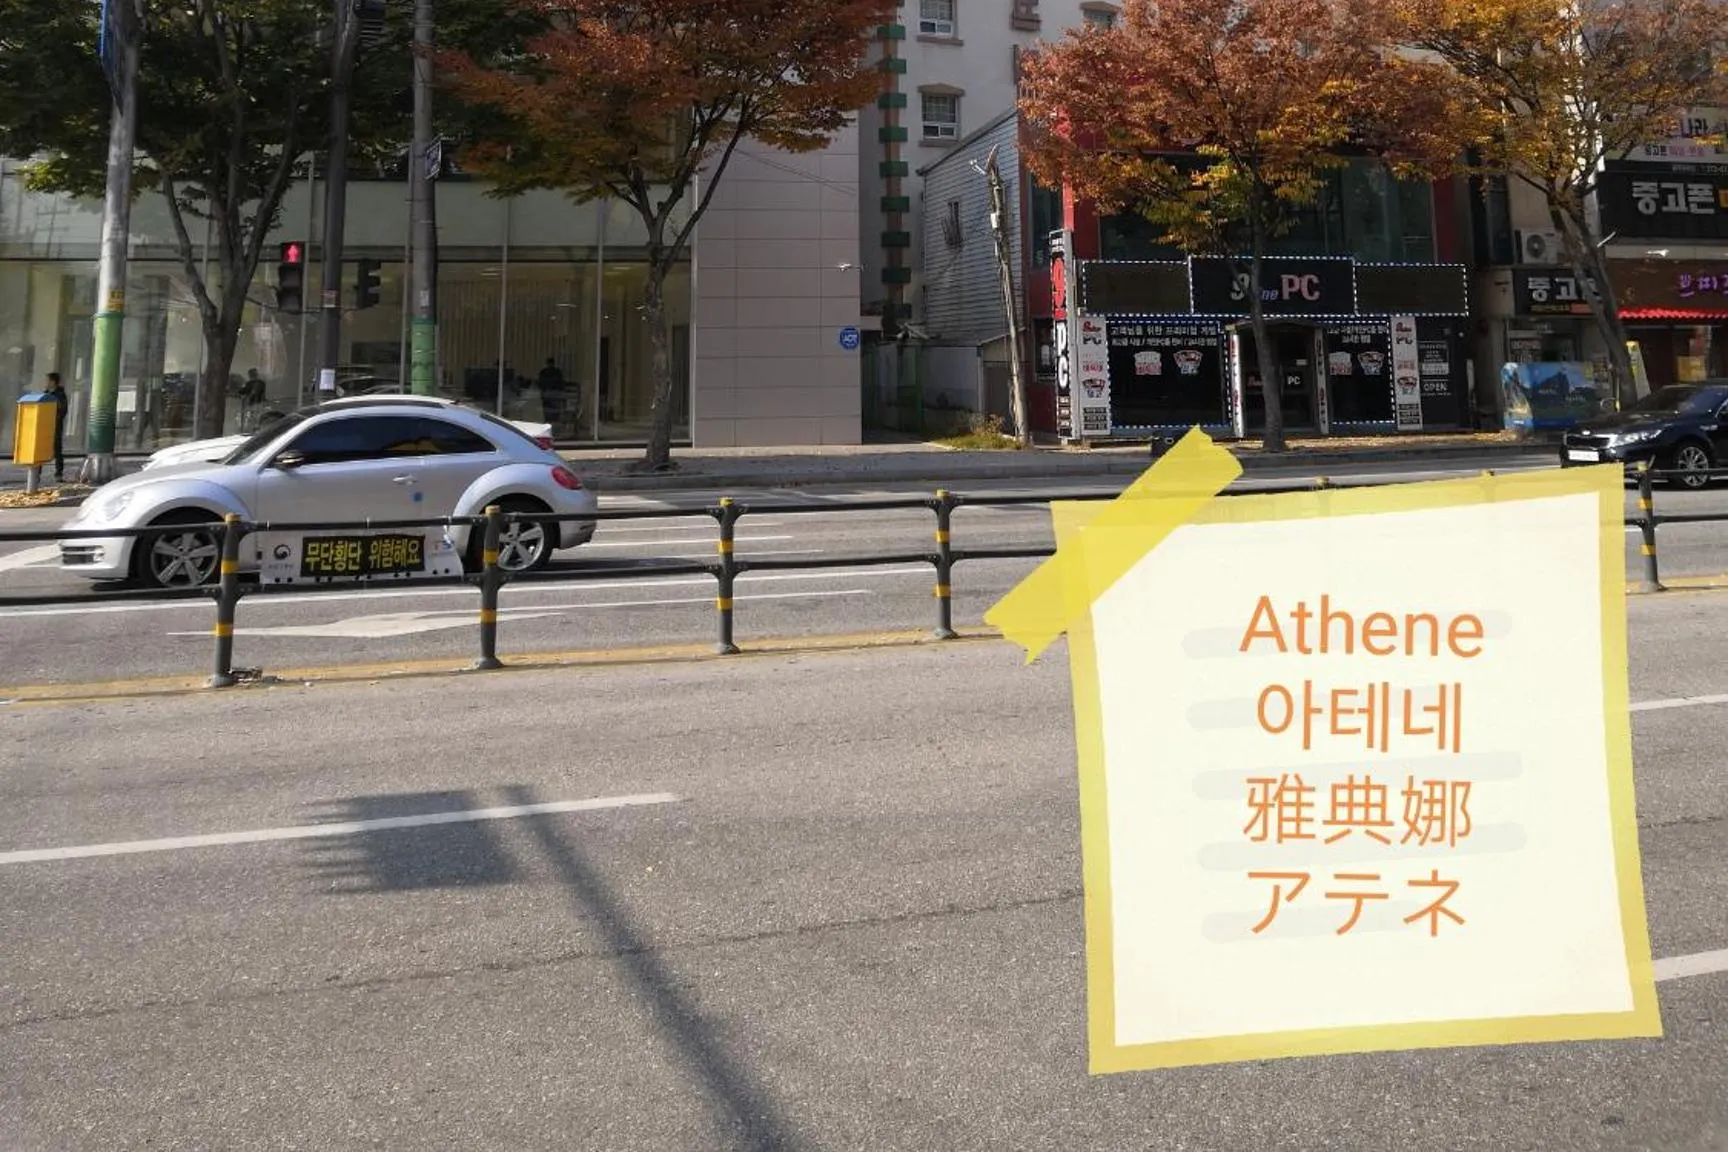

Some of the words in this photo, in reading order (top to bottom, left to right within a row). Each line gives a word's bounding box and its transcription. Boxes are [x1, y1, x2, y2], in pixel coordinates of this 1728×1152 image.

[1632, 182, 1715, 215] 중고폰
[1280, 273, 1321, 301] PC
[305, 540, 362, 571] 무단횡단
[368, 538, 421, 569] 위험해요
